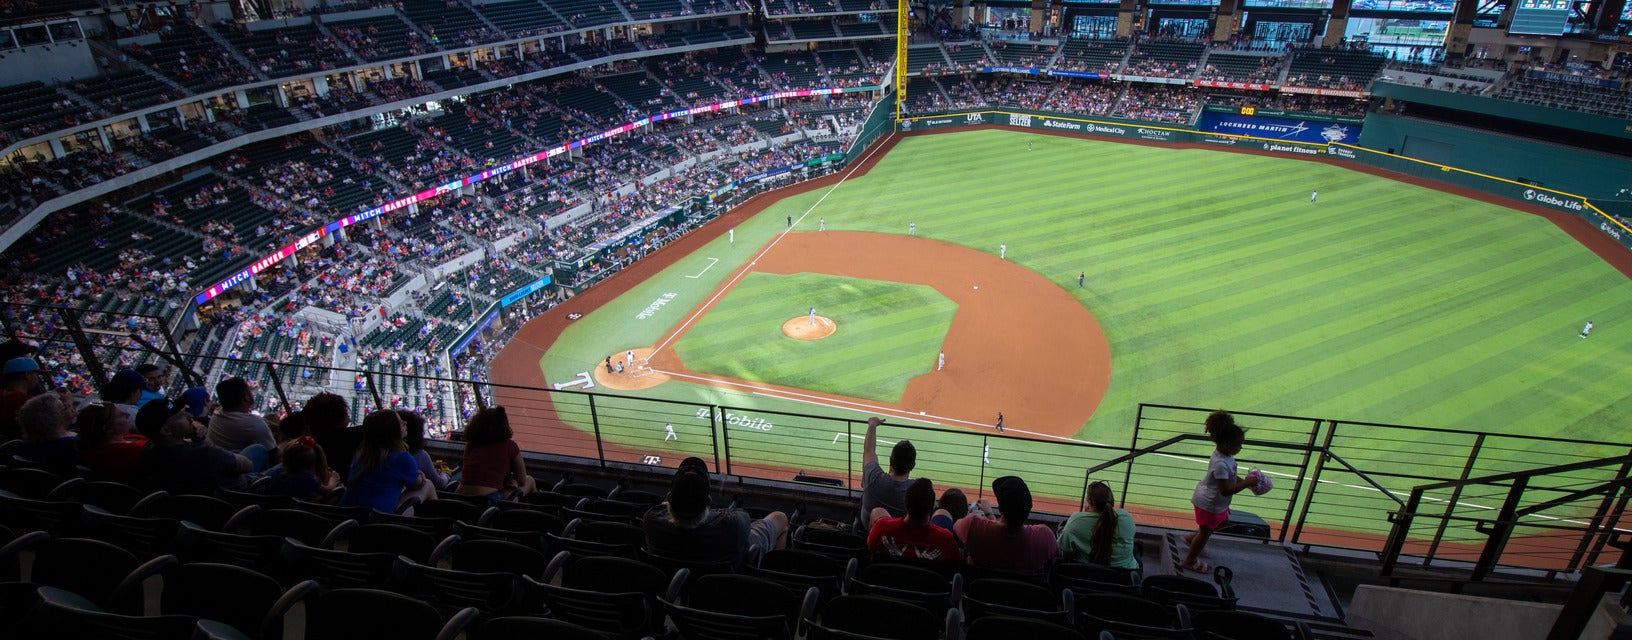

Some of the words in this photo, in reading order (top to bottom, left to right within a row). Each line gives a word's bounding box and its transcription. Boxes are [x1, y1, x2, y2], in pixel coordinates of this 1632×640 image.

[967, 113, 982, 121] UTA
[1010, 117, 1031, 127] SELTZER
[1220, 121, 1256, 130] LOCKHEED
[1270, 143, 1292, 153] planet
[1293, 144, 1317, 155] fitness
[491, 164, 512, 176] MITCH
[1536, 193, 1564, 207] Globe
[1564, 200, 1583, 211] Life
[353, 207, 381, 222] MITCH
[384, 195, 418, 212] GARVER
[221, 270, 250, 291] MITCH
[251, 251, 285, 274] GARVER
